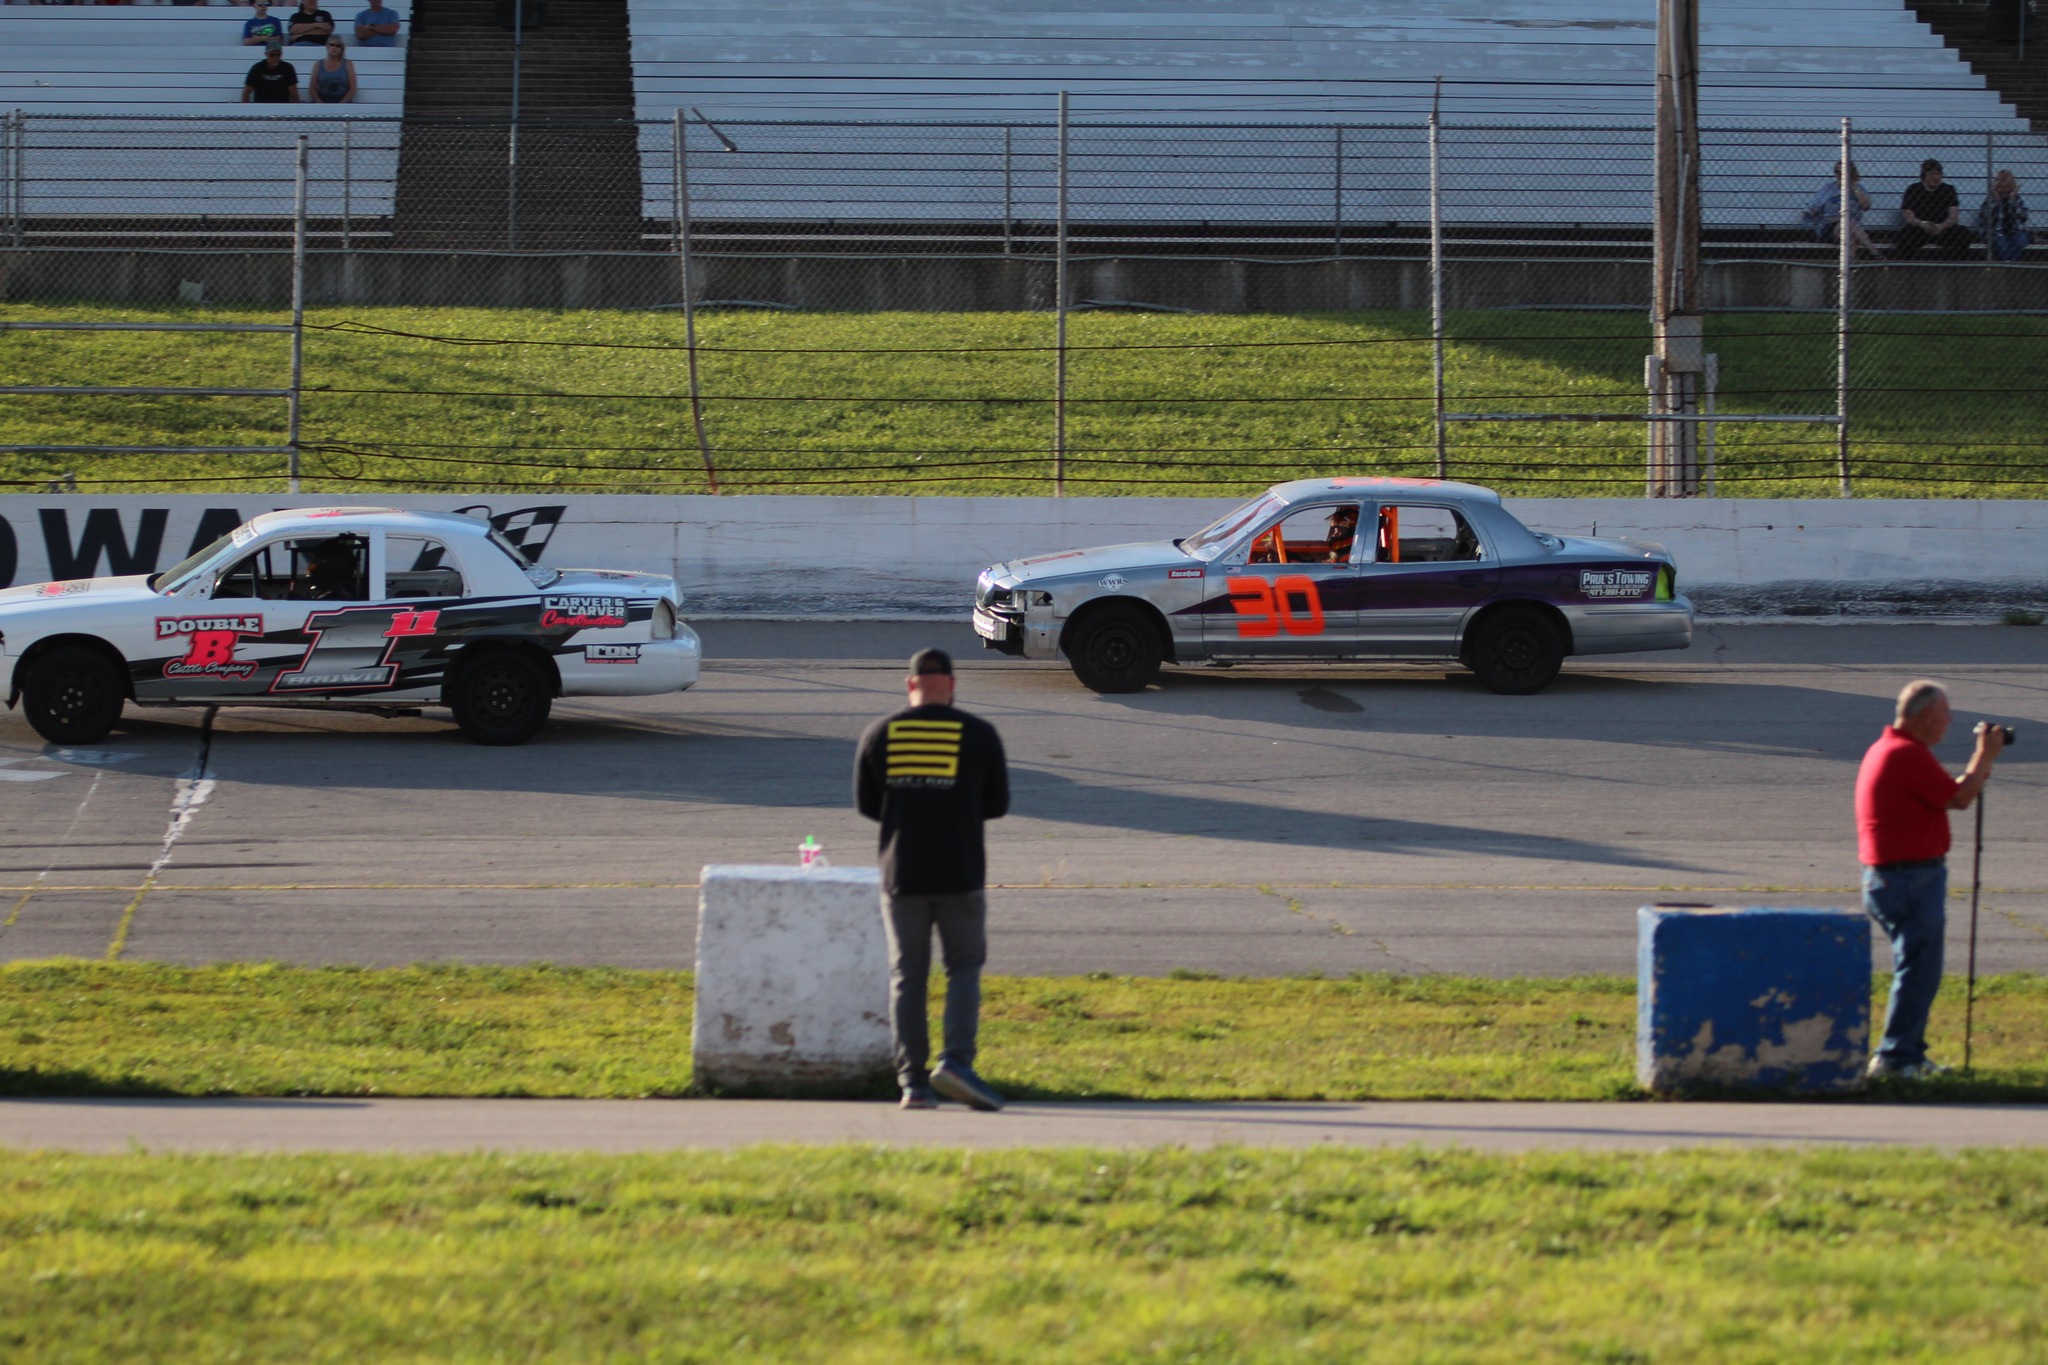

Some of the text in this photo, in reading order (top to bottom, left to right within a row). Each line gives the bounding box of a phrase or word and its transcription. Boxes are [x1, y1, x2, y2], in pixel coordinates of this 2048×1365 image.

[1170, 570, 1201, 578] RaceQuip
[1615, 572, 1649, 584] TOWING
[544, 597, 611, 609] CARVER
[1225, 574, 1325, 638] 30
[568, 606, 624, 616] CARVER
[159, 618, 260, 636] DOUBLE
[184, 630, 236, 667] B
[586, 645, 638, 659] ICON
[167, 662, 254, 676] Cattle Company
[287, 672, 384, 686] BROWN
